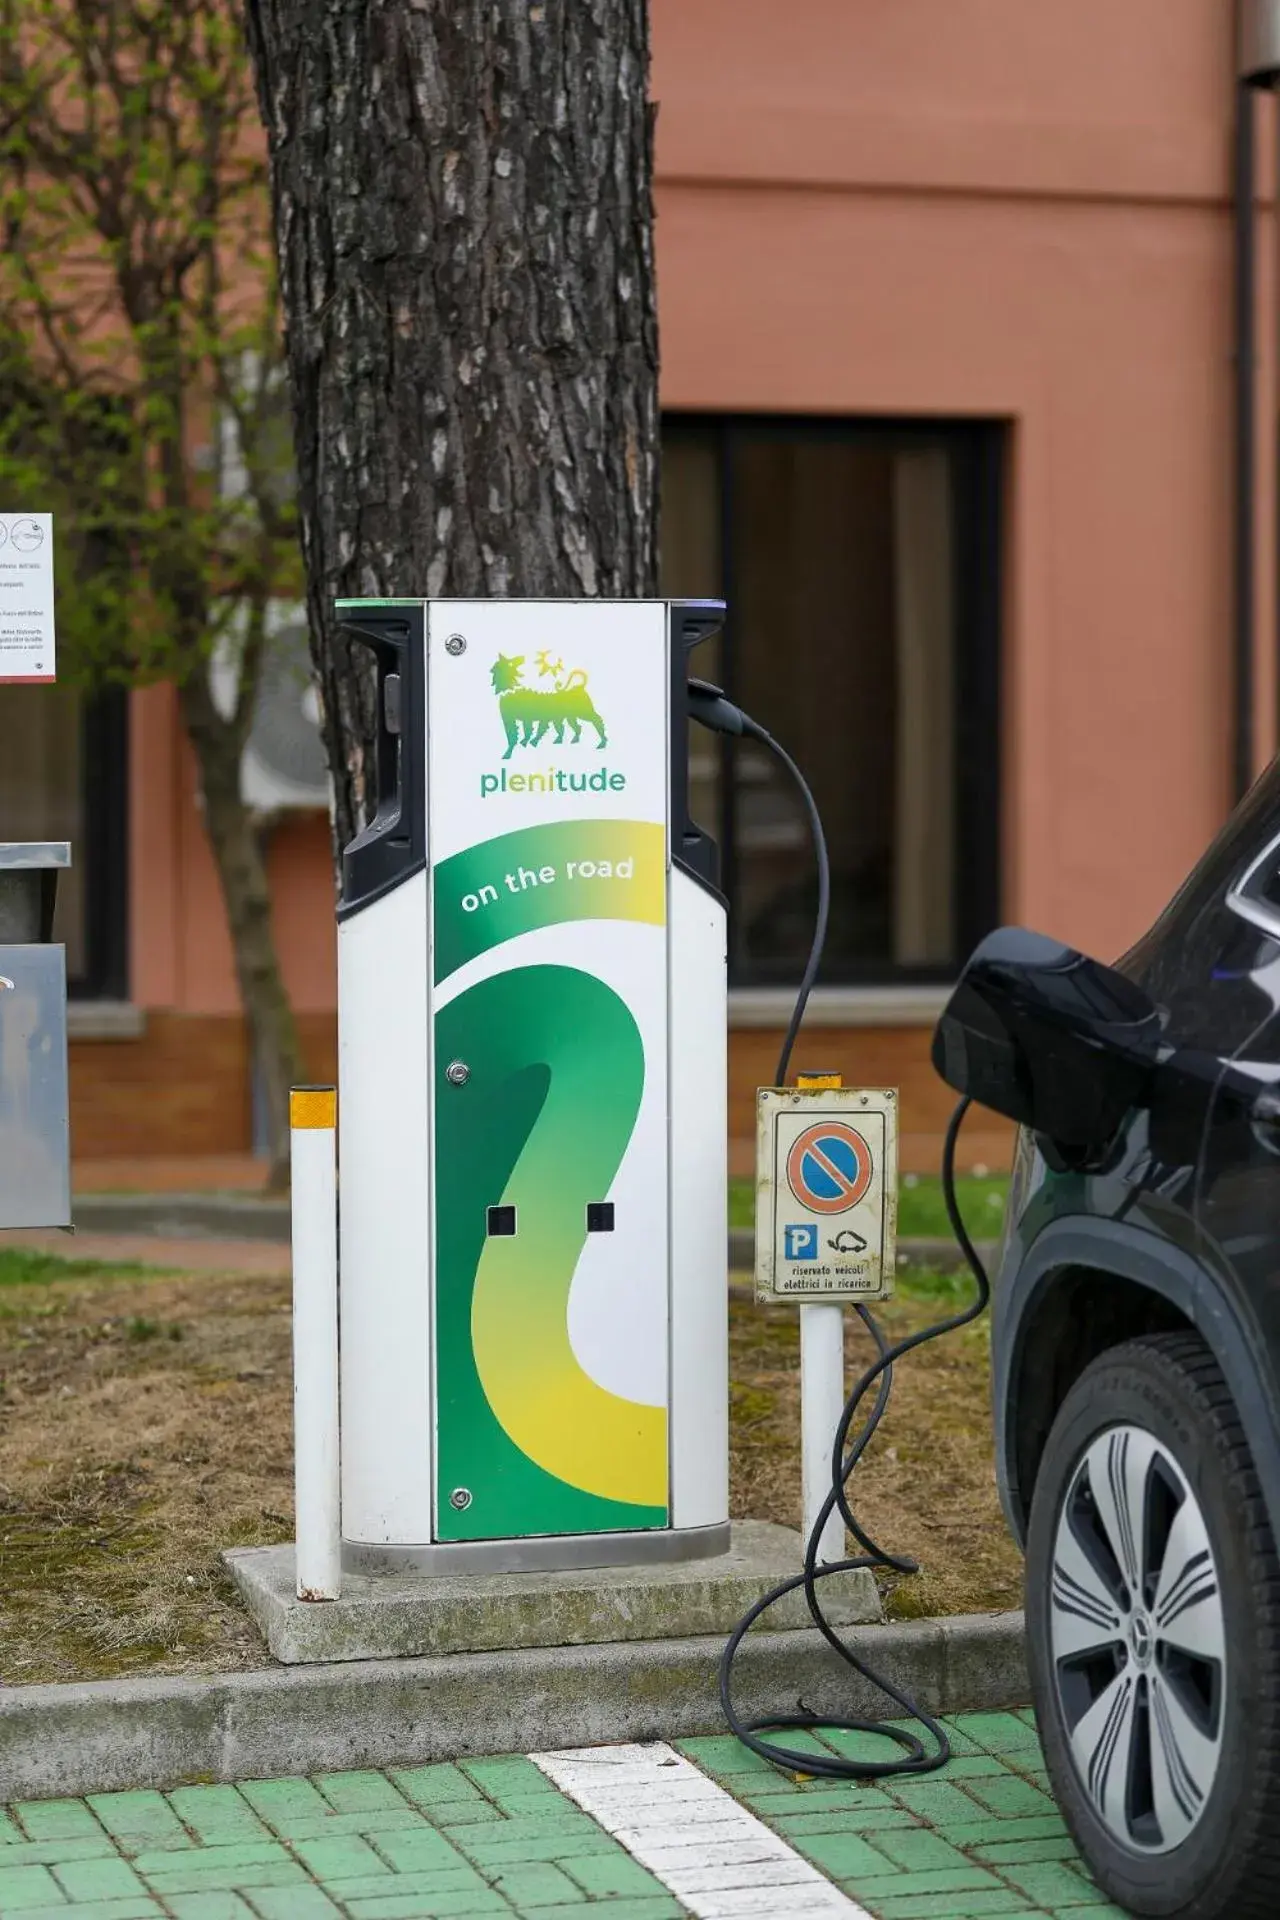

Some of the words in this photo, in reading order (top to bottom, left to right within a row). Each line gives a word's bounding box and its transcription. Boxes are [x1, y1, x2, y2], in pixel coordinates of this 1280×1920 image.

[481, 766, 626, 798] plenitude
[461, 884, 498, 912] on
[504, 865, 556, 893] the
[566, 856, 634, 879] road
[791, 1229, 811, 1256] P
[792, 1265, 831, 1275] riservato
[835, 1264, 864, 1274] veicoli
[784, 1278, 820, 1289] elettrici
[825, 1278, 833, 1288] in
[838, 1278, 871, 1288] ricarica
